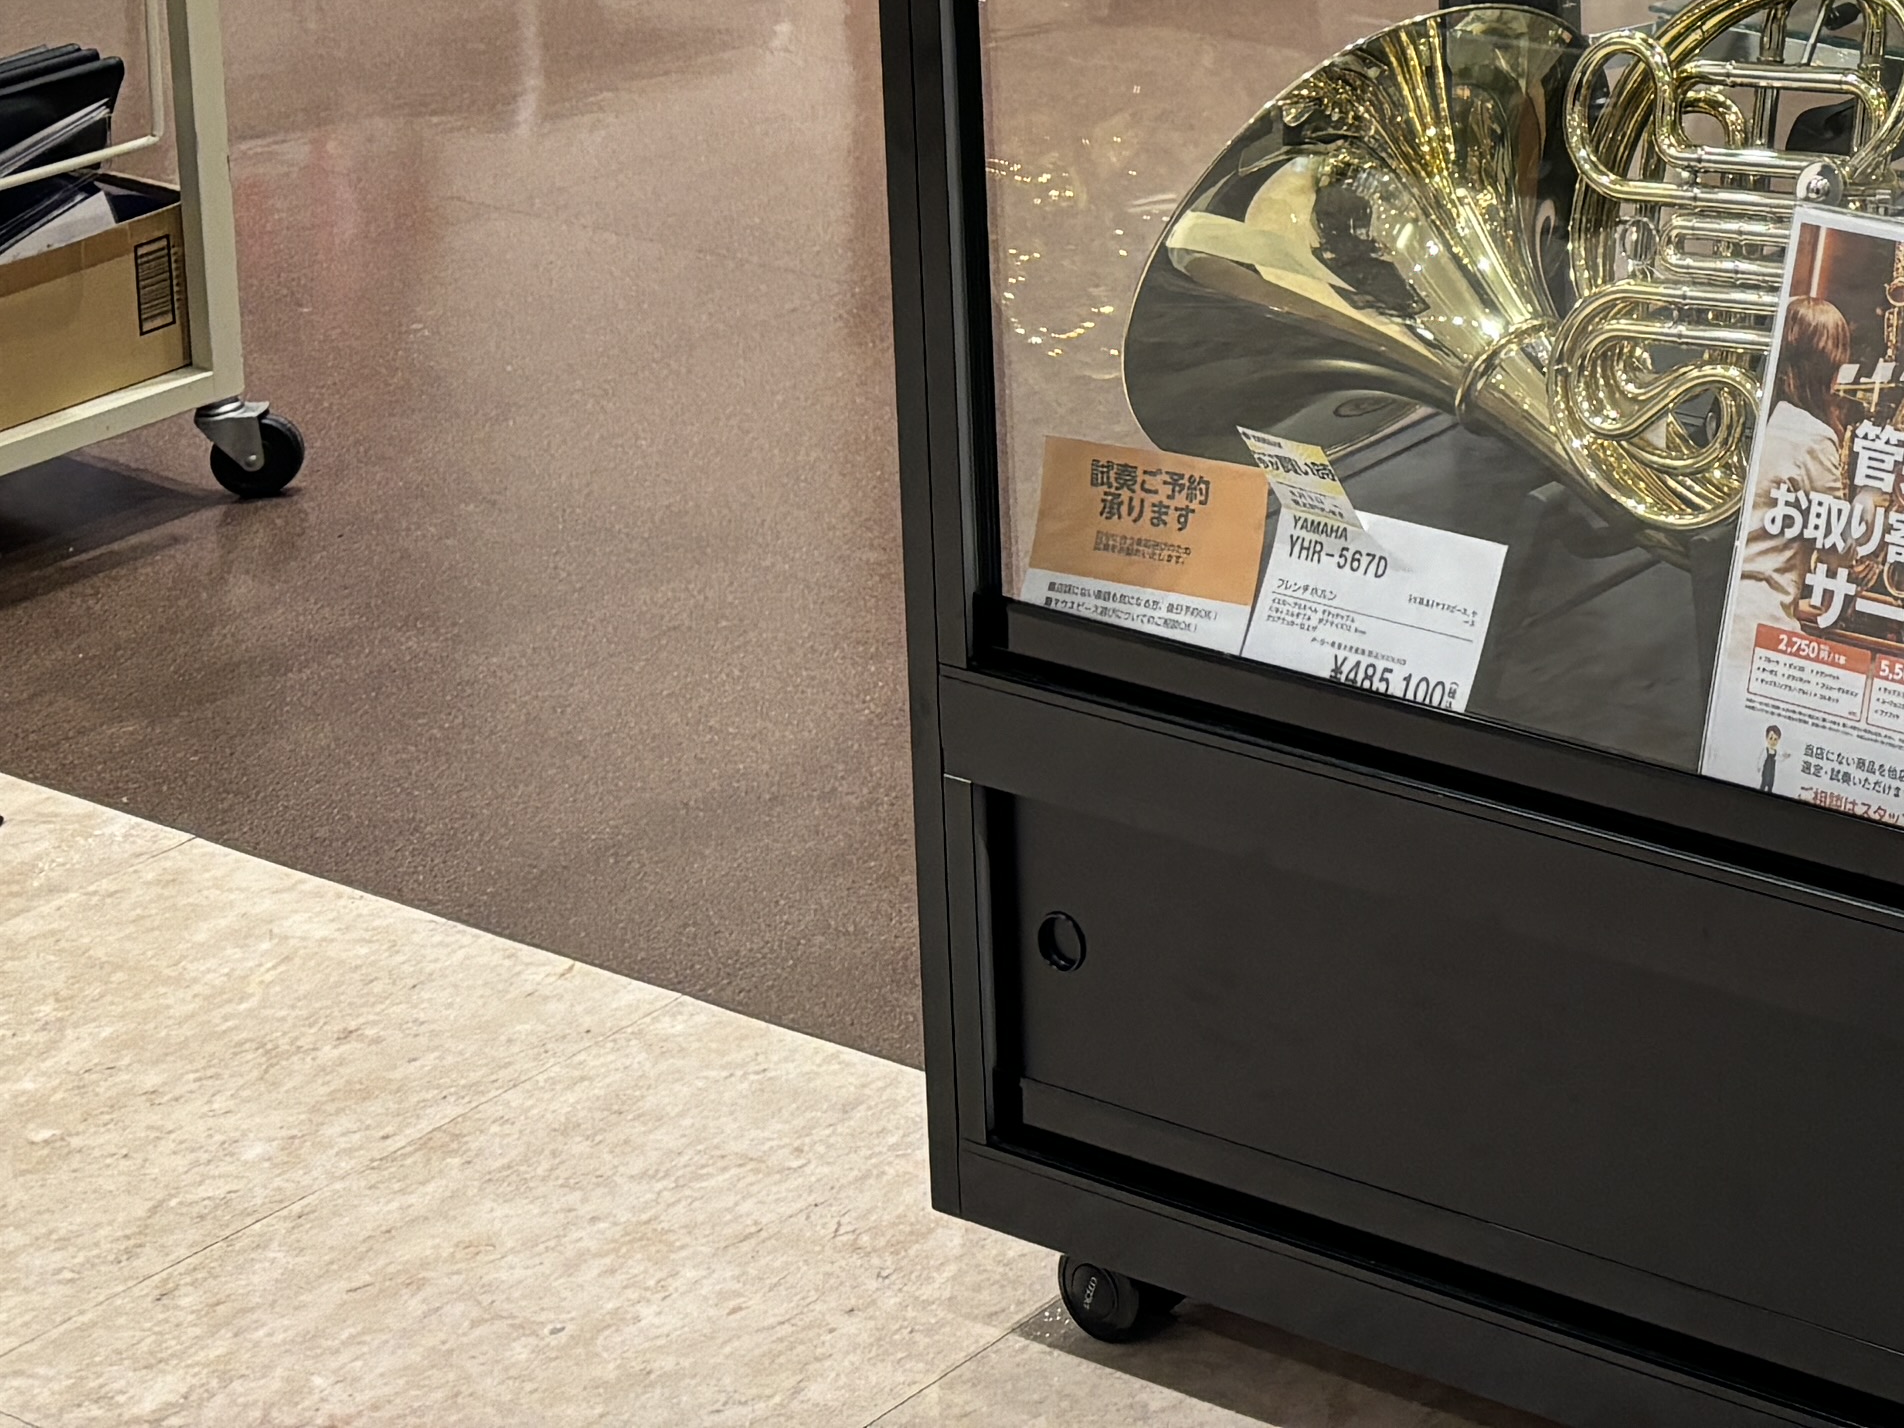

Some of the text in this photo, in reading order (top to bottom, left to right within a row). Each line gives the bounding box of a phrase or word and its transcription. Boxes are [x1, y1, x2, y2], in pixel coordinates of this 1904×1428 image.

[1089, 458, 1211, 506] 試奏ご予約
[1099, 492, 1196, 531] 承ります
[1291, 515, 1349, 542] YAMAHA
[1288, 535, 1388, 580] YHR-567D
[1329, 653, 1445, 707] ¥485,100
